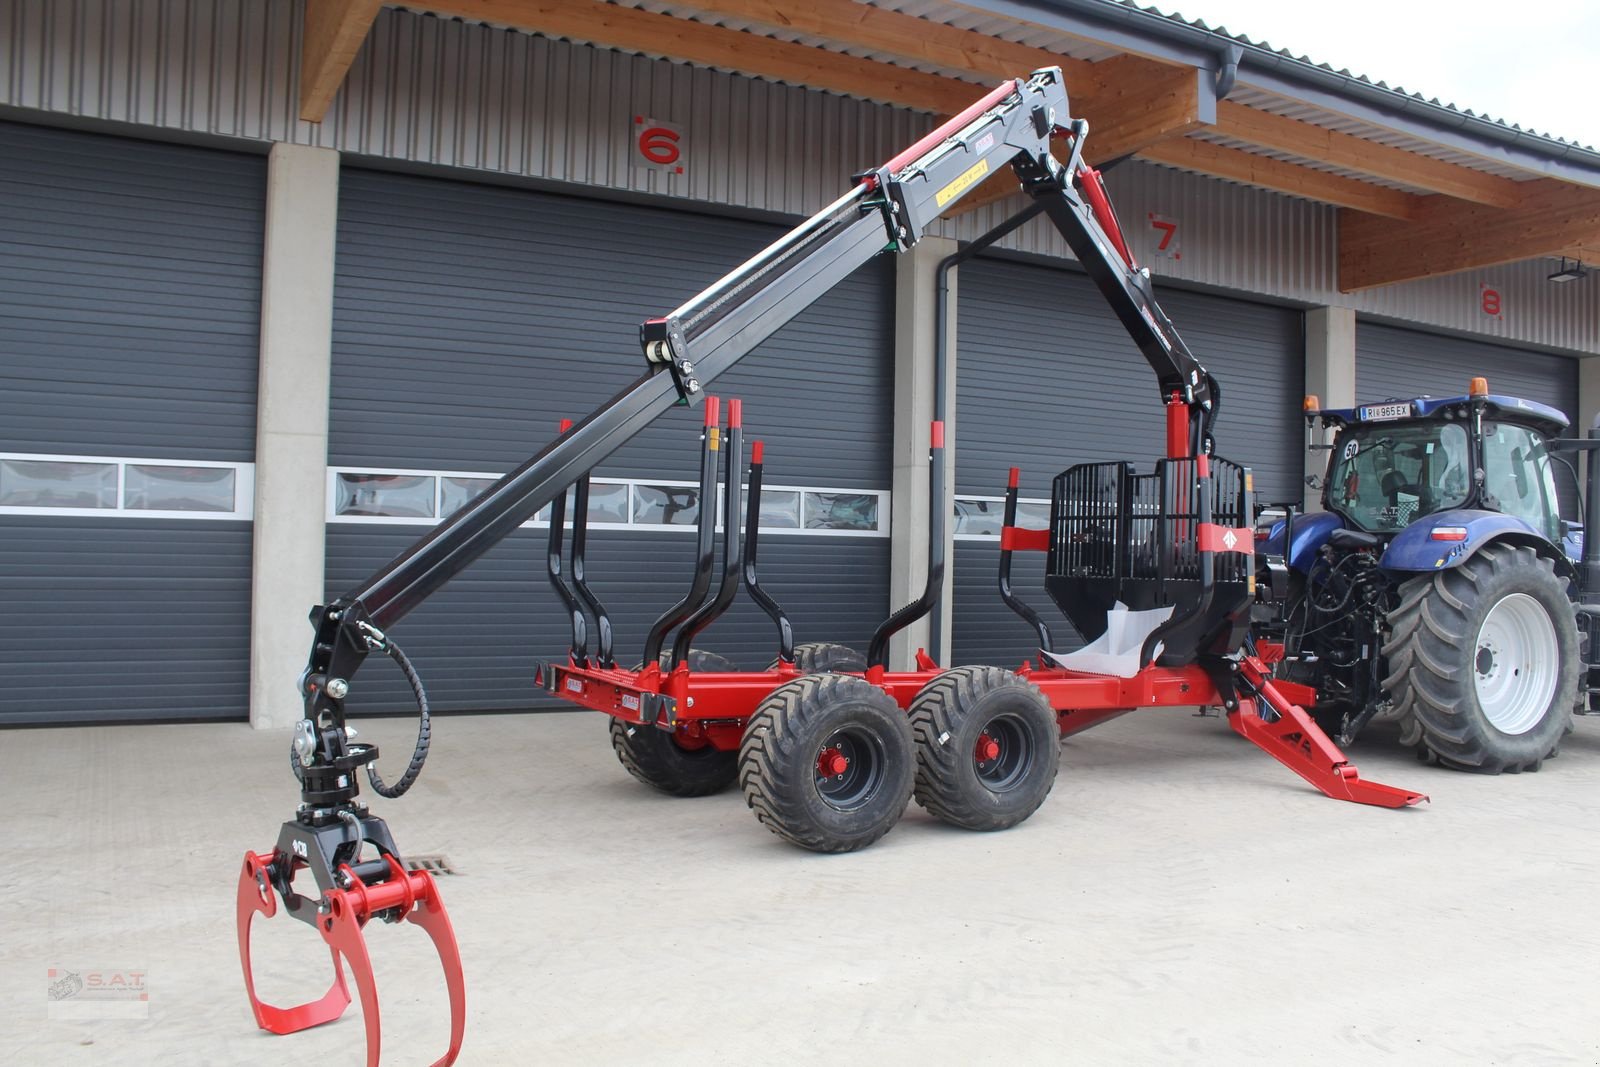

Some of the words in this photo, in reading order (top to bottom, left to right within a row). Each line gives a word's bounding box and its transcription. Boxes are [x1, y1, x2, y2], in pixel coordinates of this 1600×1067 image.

[640, 128, 680, 165] 6
[1152, 221, 1177, 250] 7
[1482, 289, 1501, 315] 8
[1346, 443, 1357, 458] 50
